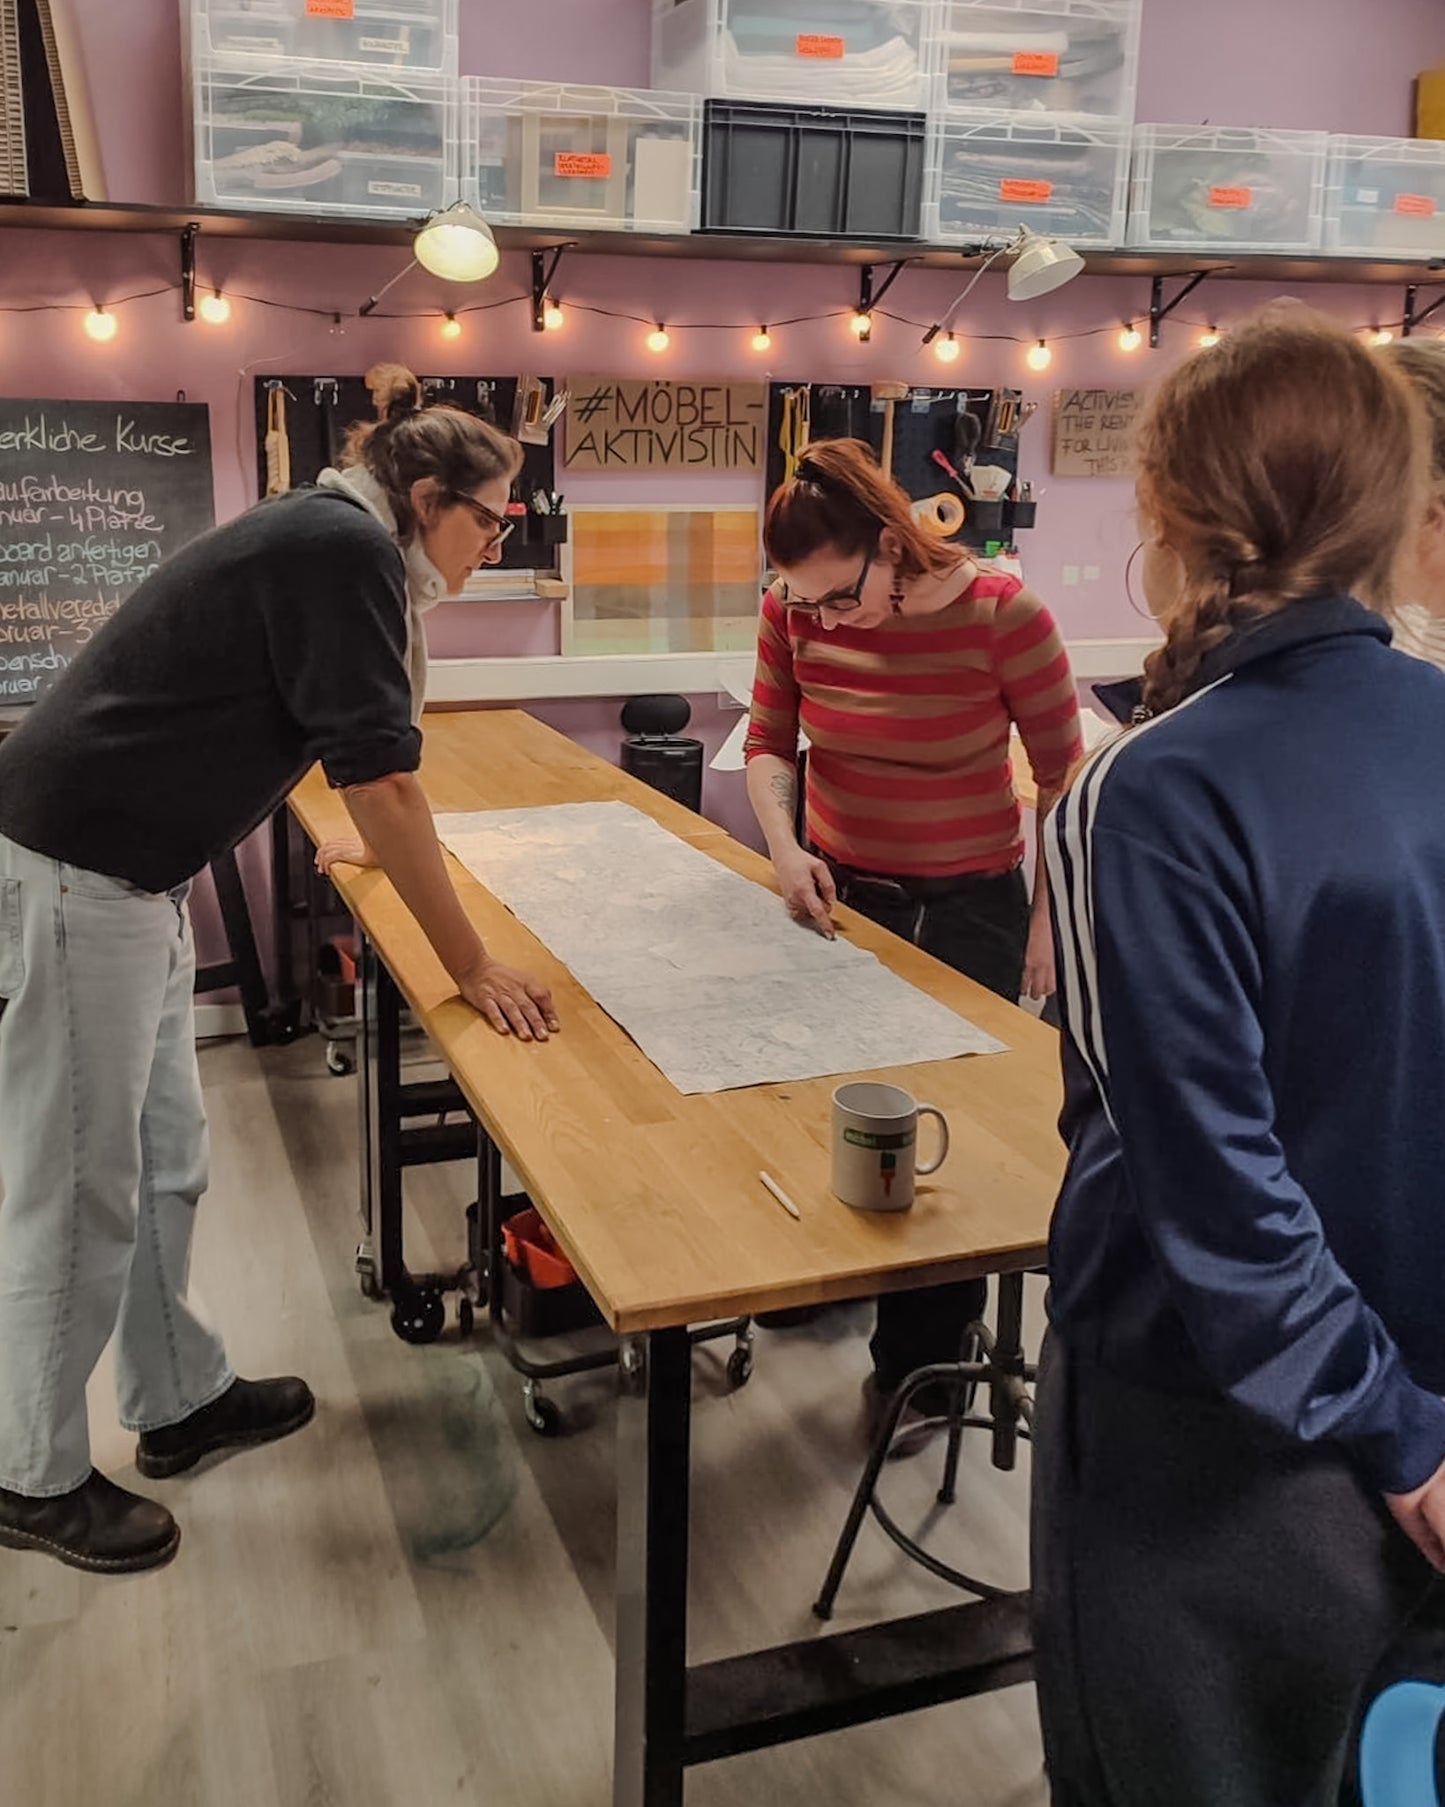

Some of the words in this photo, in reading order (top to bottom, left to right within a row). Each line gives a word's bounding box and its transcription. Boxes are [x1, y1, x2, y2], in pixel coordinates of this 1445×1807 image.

[1063, 389, 1138, 412] ACTIVIS
[116, 414, 196, 456] Kurse
[1061, 415, 1096, 433] THE
[563, 425, 757, 469] AKTIVISTIN
